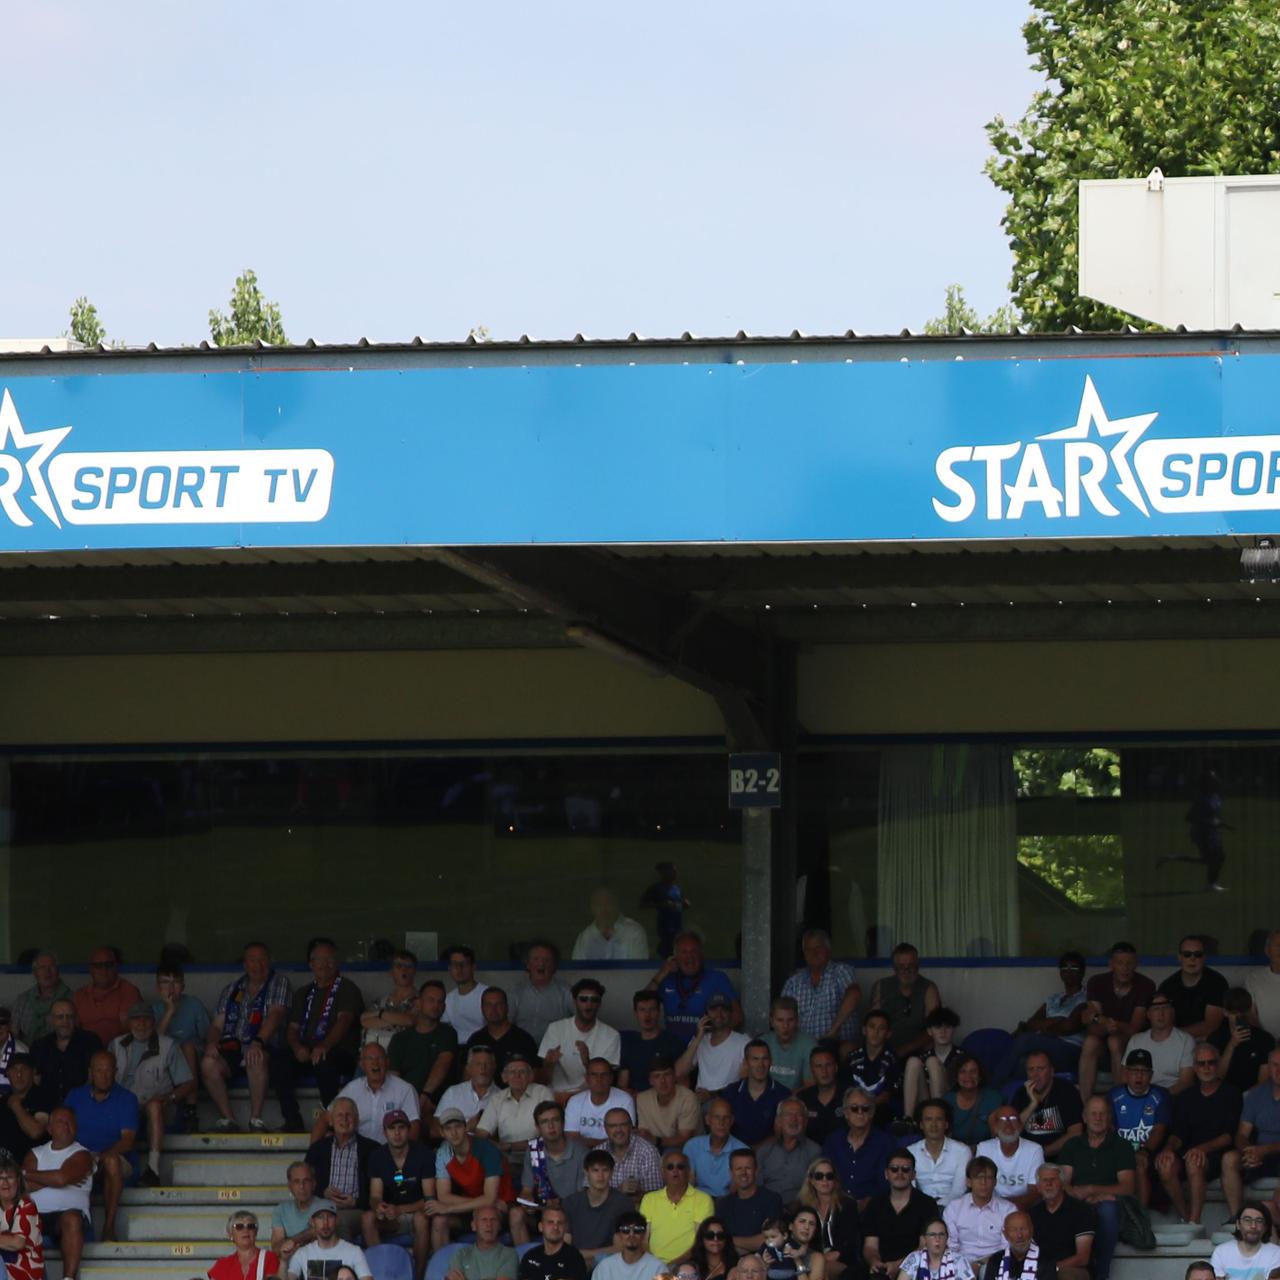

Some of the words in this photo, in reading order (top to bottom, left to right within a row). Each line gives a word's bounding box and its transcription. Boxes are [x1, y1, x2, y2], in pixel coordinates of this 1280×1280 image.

[72, 465, 240, 511] SPORT
[263, 467, 319, 503] TV
[932, 441, 1121, 523] STAR
[730, 767, 780, 793] B2-2
[998, 1174, 1025, 1186] OSS
